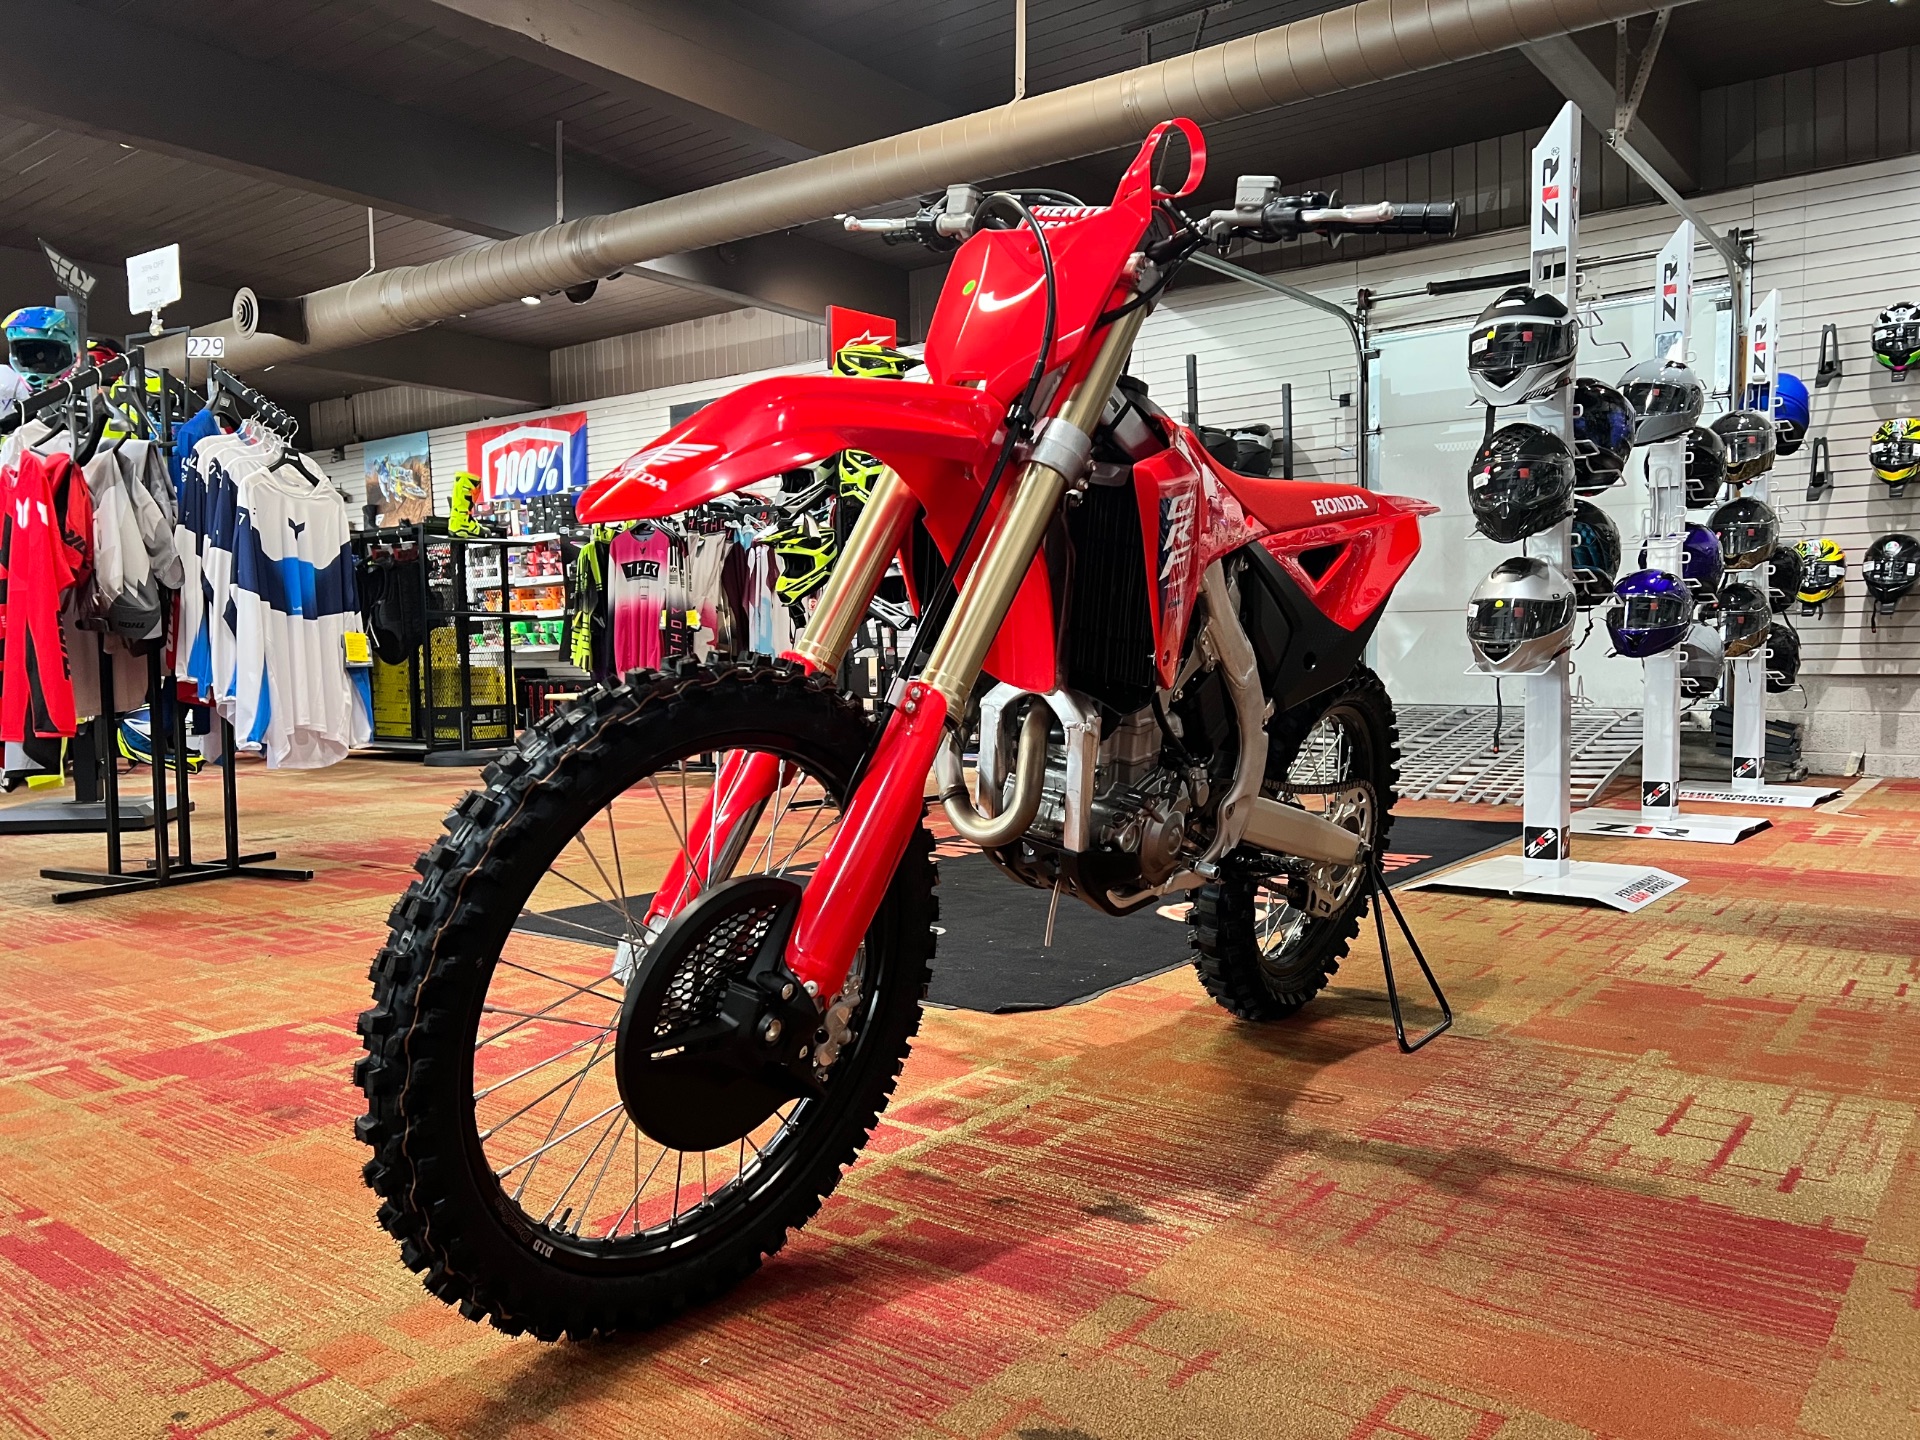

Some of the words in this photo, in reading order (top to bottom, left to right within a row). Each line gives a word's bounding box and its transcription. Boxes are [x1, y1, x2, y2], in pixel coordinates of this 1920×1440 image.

[188, 338, 223, 356] 229
[494, 445, 558, 495] 100%
[1311, 494, 1369, 516] HONDA
[627, 562, 659, 576] THOR
